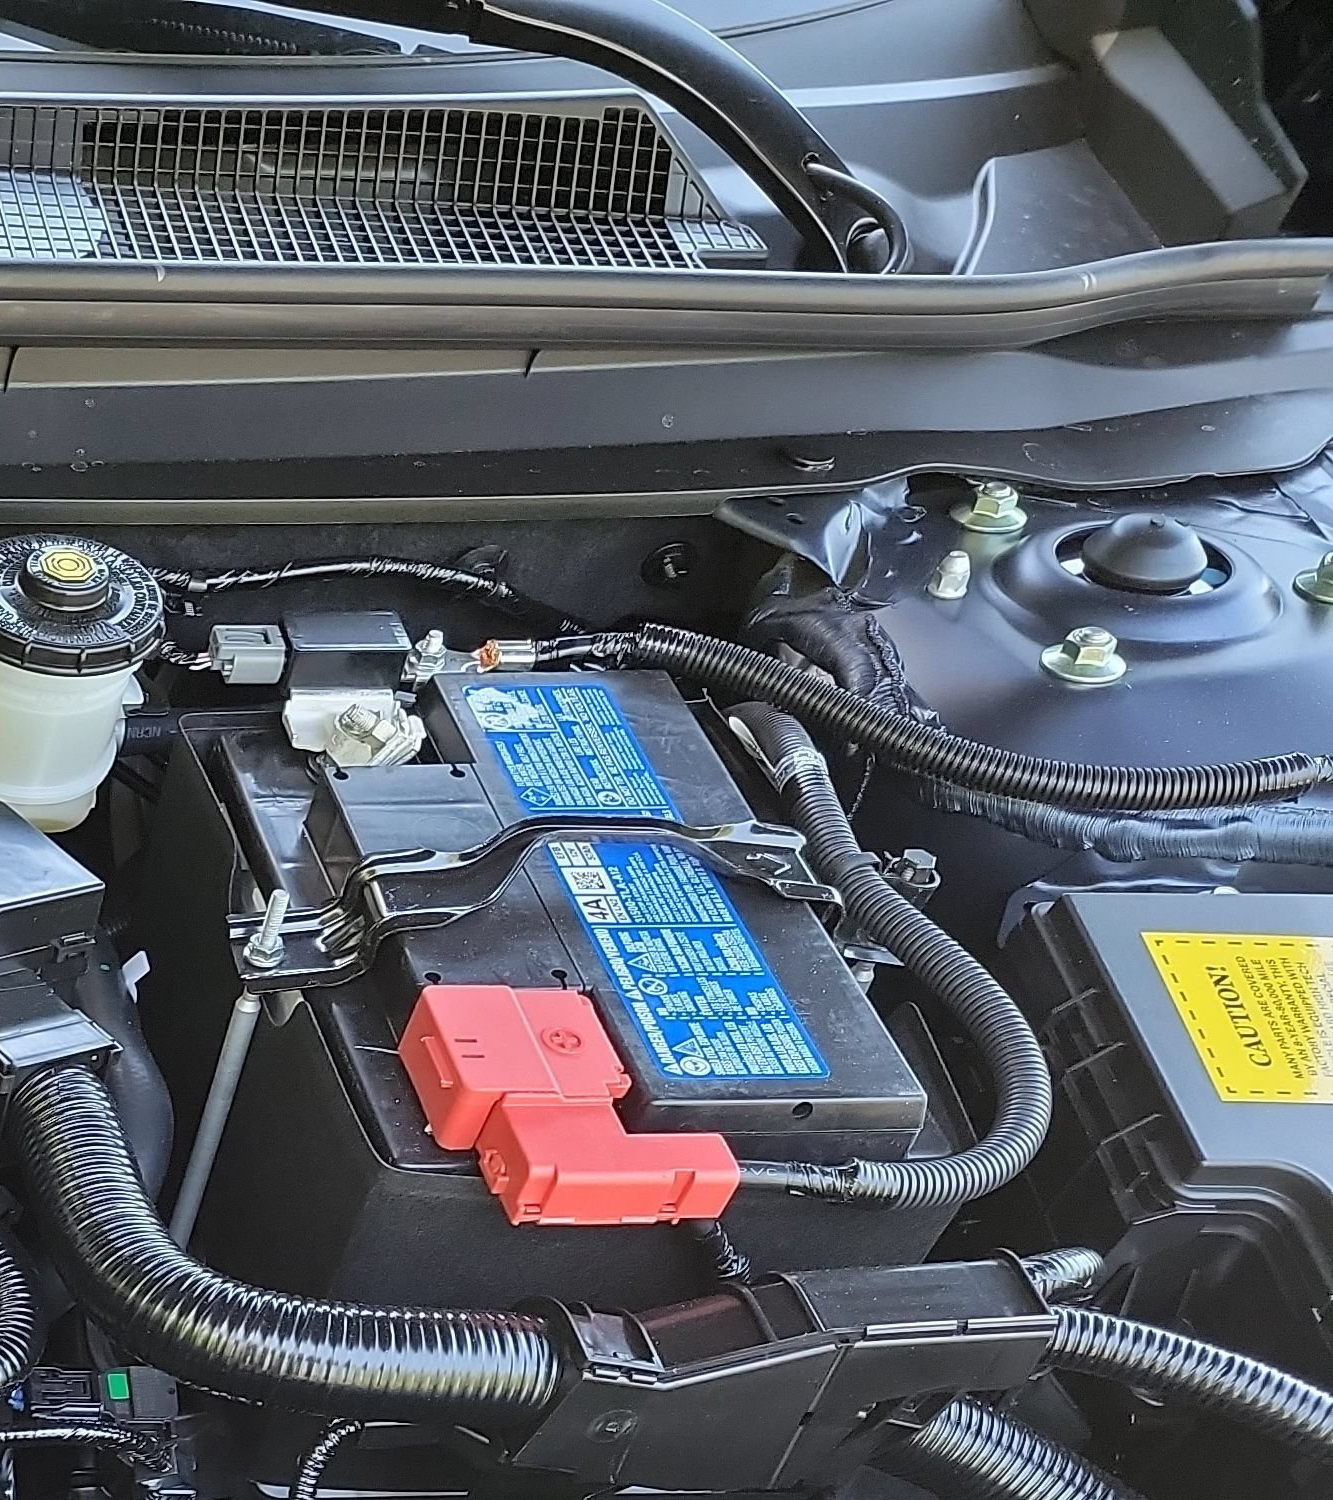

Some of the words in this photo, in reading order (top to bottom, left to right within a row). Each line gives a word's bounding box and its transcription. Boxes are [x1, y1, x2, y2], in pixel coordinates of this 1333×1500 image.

[551, 846, 566, 859] EFB
[579, 898, 612, 920] 4A
[1233, 955, 1264, 998] COVERED
[1249, 958, 1271, 980] MILE
[1203, 965, 1275, 1067] CAUTION!
[1255, 999, 1274, 1018] ARE
[1265, 1019, 1290, 1049] PARTS
[1281, 1050, 1305, 1078] MANY
[1294, 1048, 1312, 1062] AN
